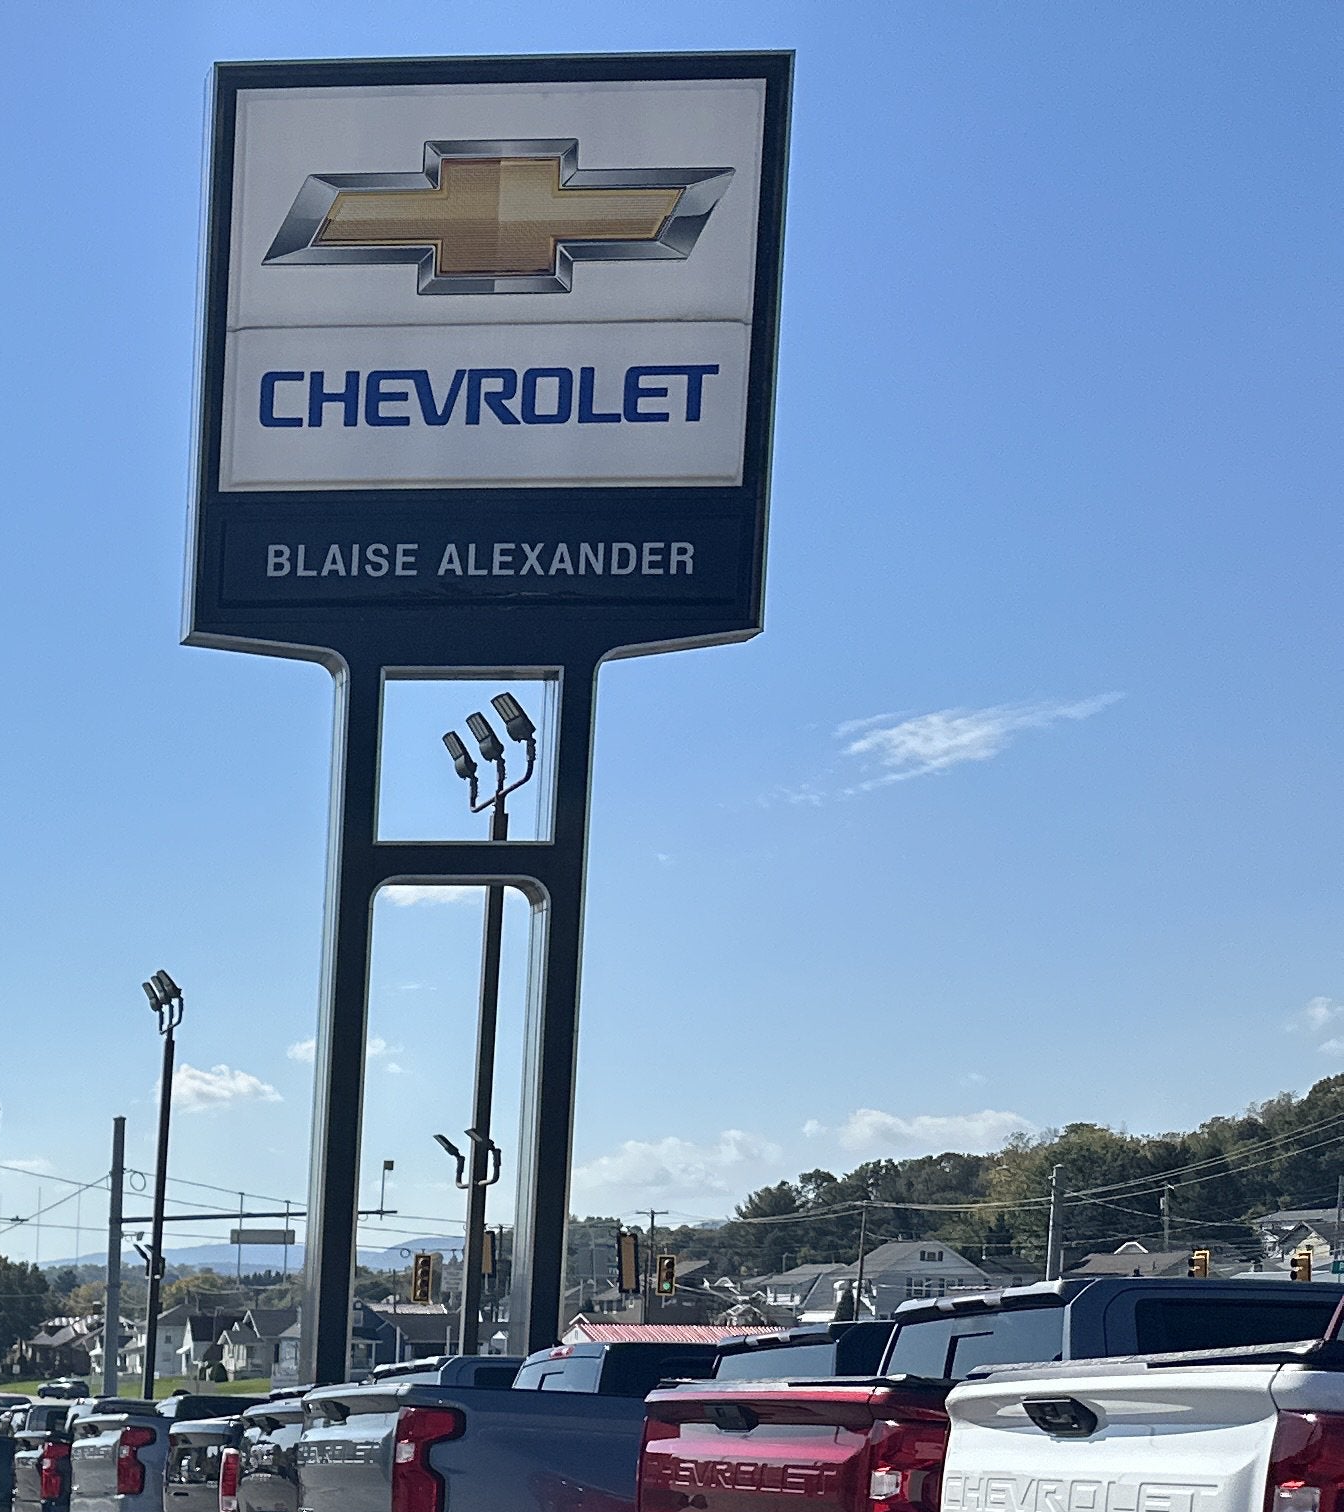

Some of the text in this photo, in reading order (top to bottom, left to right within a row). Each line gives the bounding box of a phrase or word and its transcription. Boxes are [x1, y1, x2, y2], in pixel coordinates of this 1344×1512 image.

[260, 364, 720, 427] CHEVROLET
[266, 541, 696, 577] BLAISE ALEXANDER
[643, 1460, 837, 1496] CHEVROLET
